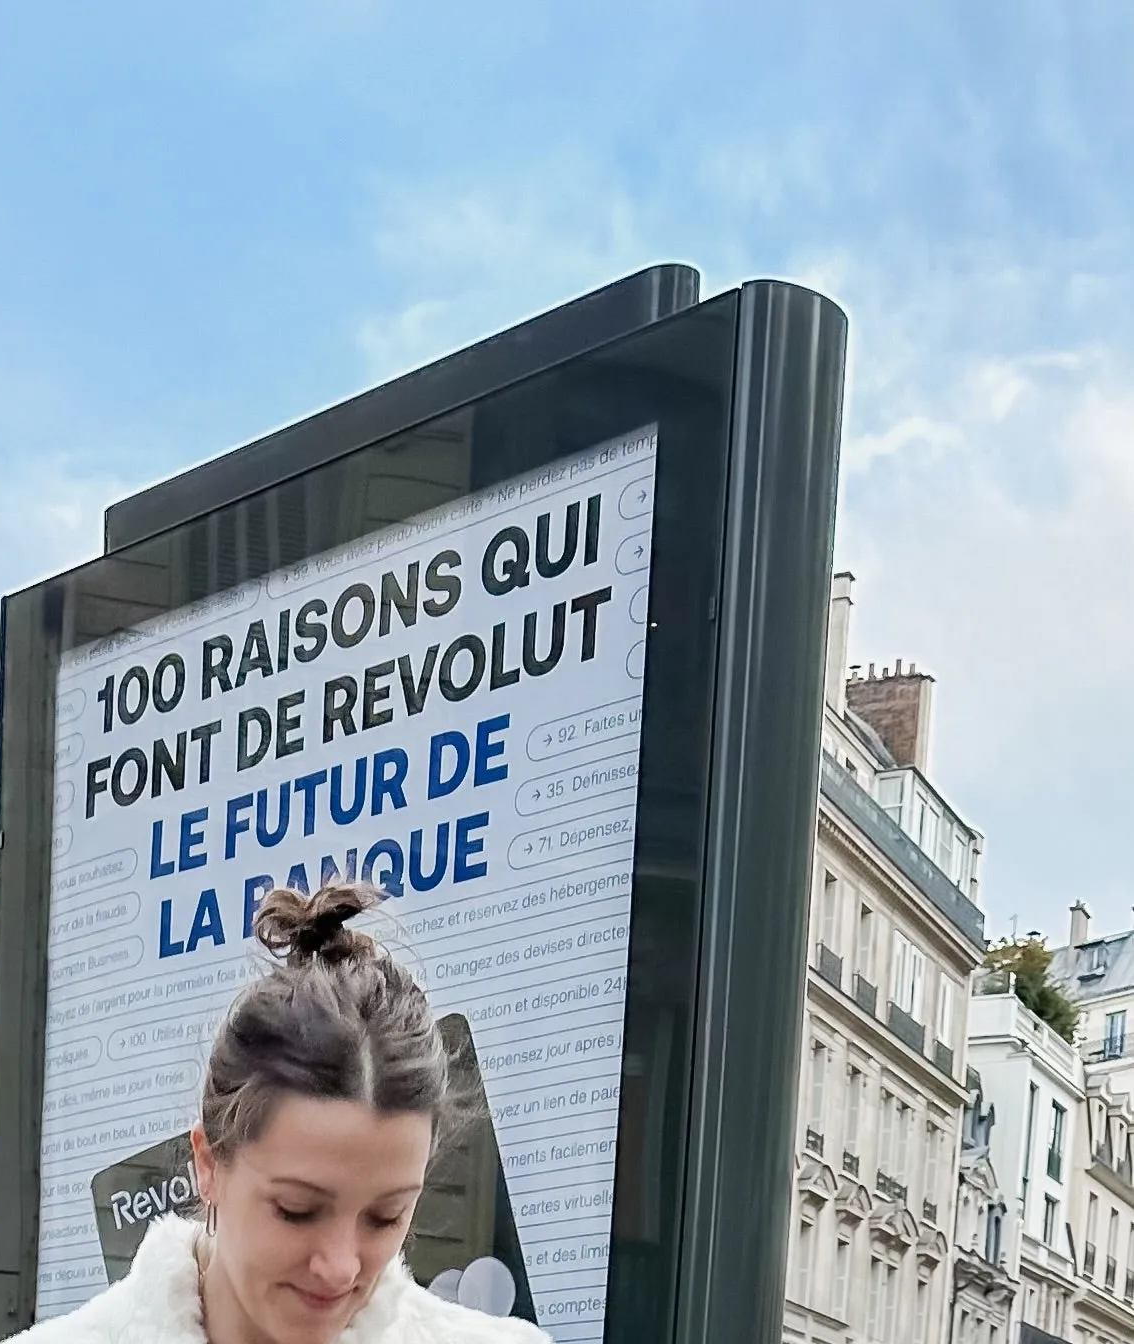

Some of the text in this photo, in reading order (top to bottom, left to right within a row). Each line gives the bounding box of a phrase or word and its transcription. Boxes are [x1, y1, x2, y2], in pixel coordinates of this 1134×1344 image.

[497, 484, 516, 504] Ne
[519, 469, 566, 499] perdez
[570, 457, 596, 480] pas
[599, 448, 618, 465] de
[97, 652, 185, 734] 100
[201, 548, 463, 700] RAISONS
[481, 494, 602, 596] QUI
[85, 719, 223, 820] FONT
[237, 696, 306, 773] DE
[322, 585, 613, 744] REVOLUT
[584, 712, 625, 737] Faites
[149, 713, 512, 880] LE FUTUR DE
[447, 910, 461, 927] et
[521, 890, 546, 909] des
[549, 872, 632, 903] hébergeme
[158, 888, 226, 960] LA
[435, 954, 493, 980] Changez
[495, 948, 520, 966] des
[523, 938, 573, 960] devises
[576, 925, 629, 948] directe
[128, 987, 151, 1007] pour
[217, 968, 236, 983] fois
[515, 998, 528, 1014] et
[531, 982, 601, 1011] disponible
[545, 1041, 572, 1064] jour
[523, 1101, 540, 1114] un
[543, 1093, 566, 1112] lien
[569, 1089, 587, 1106] de
[77, 1133, 97, 1148] bout
[99, 1131, 111, 1143] en
[173, 1115, 188, 1130] les
[521, 1198, 560, 1218] cartes
[536, 1251, 549, 1266] et
[552, 1247, 577, 1264] des
